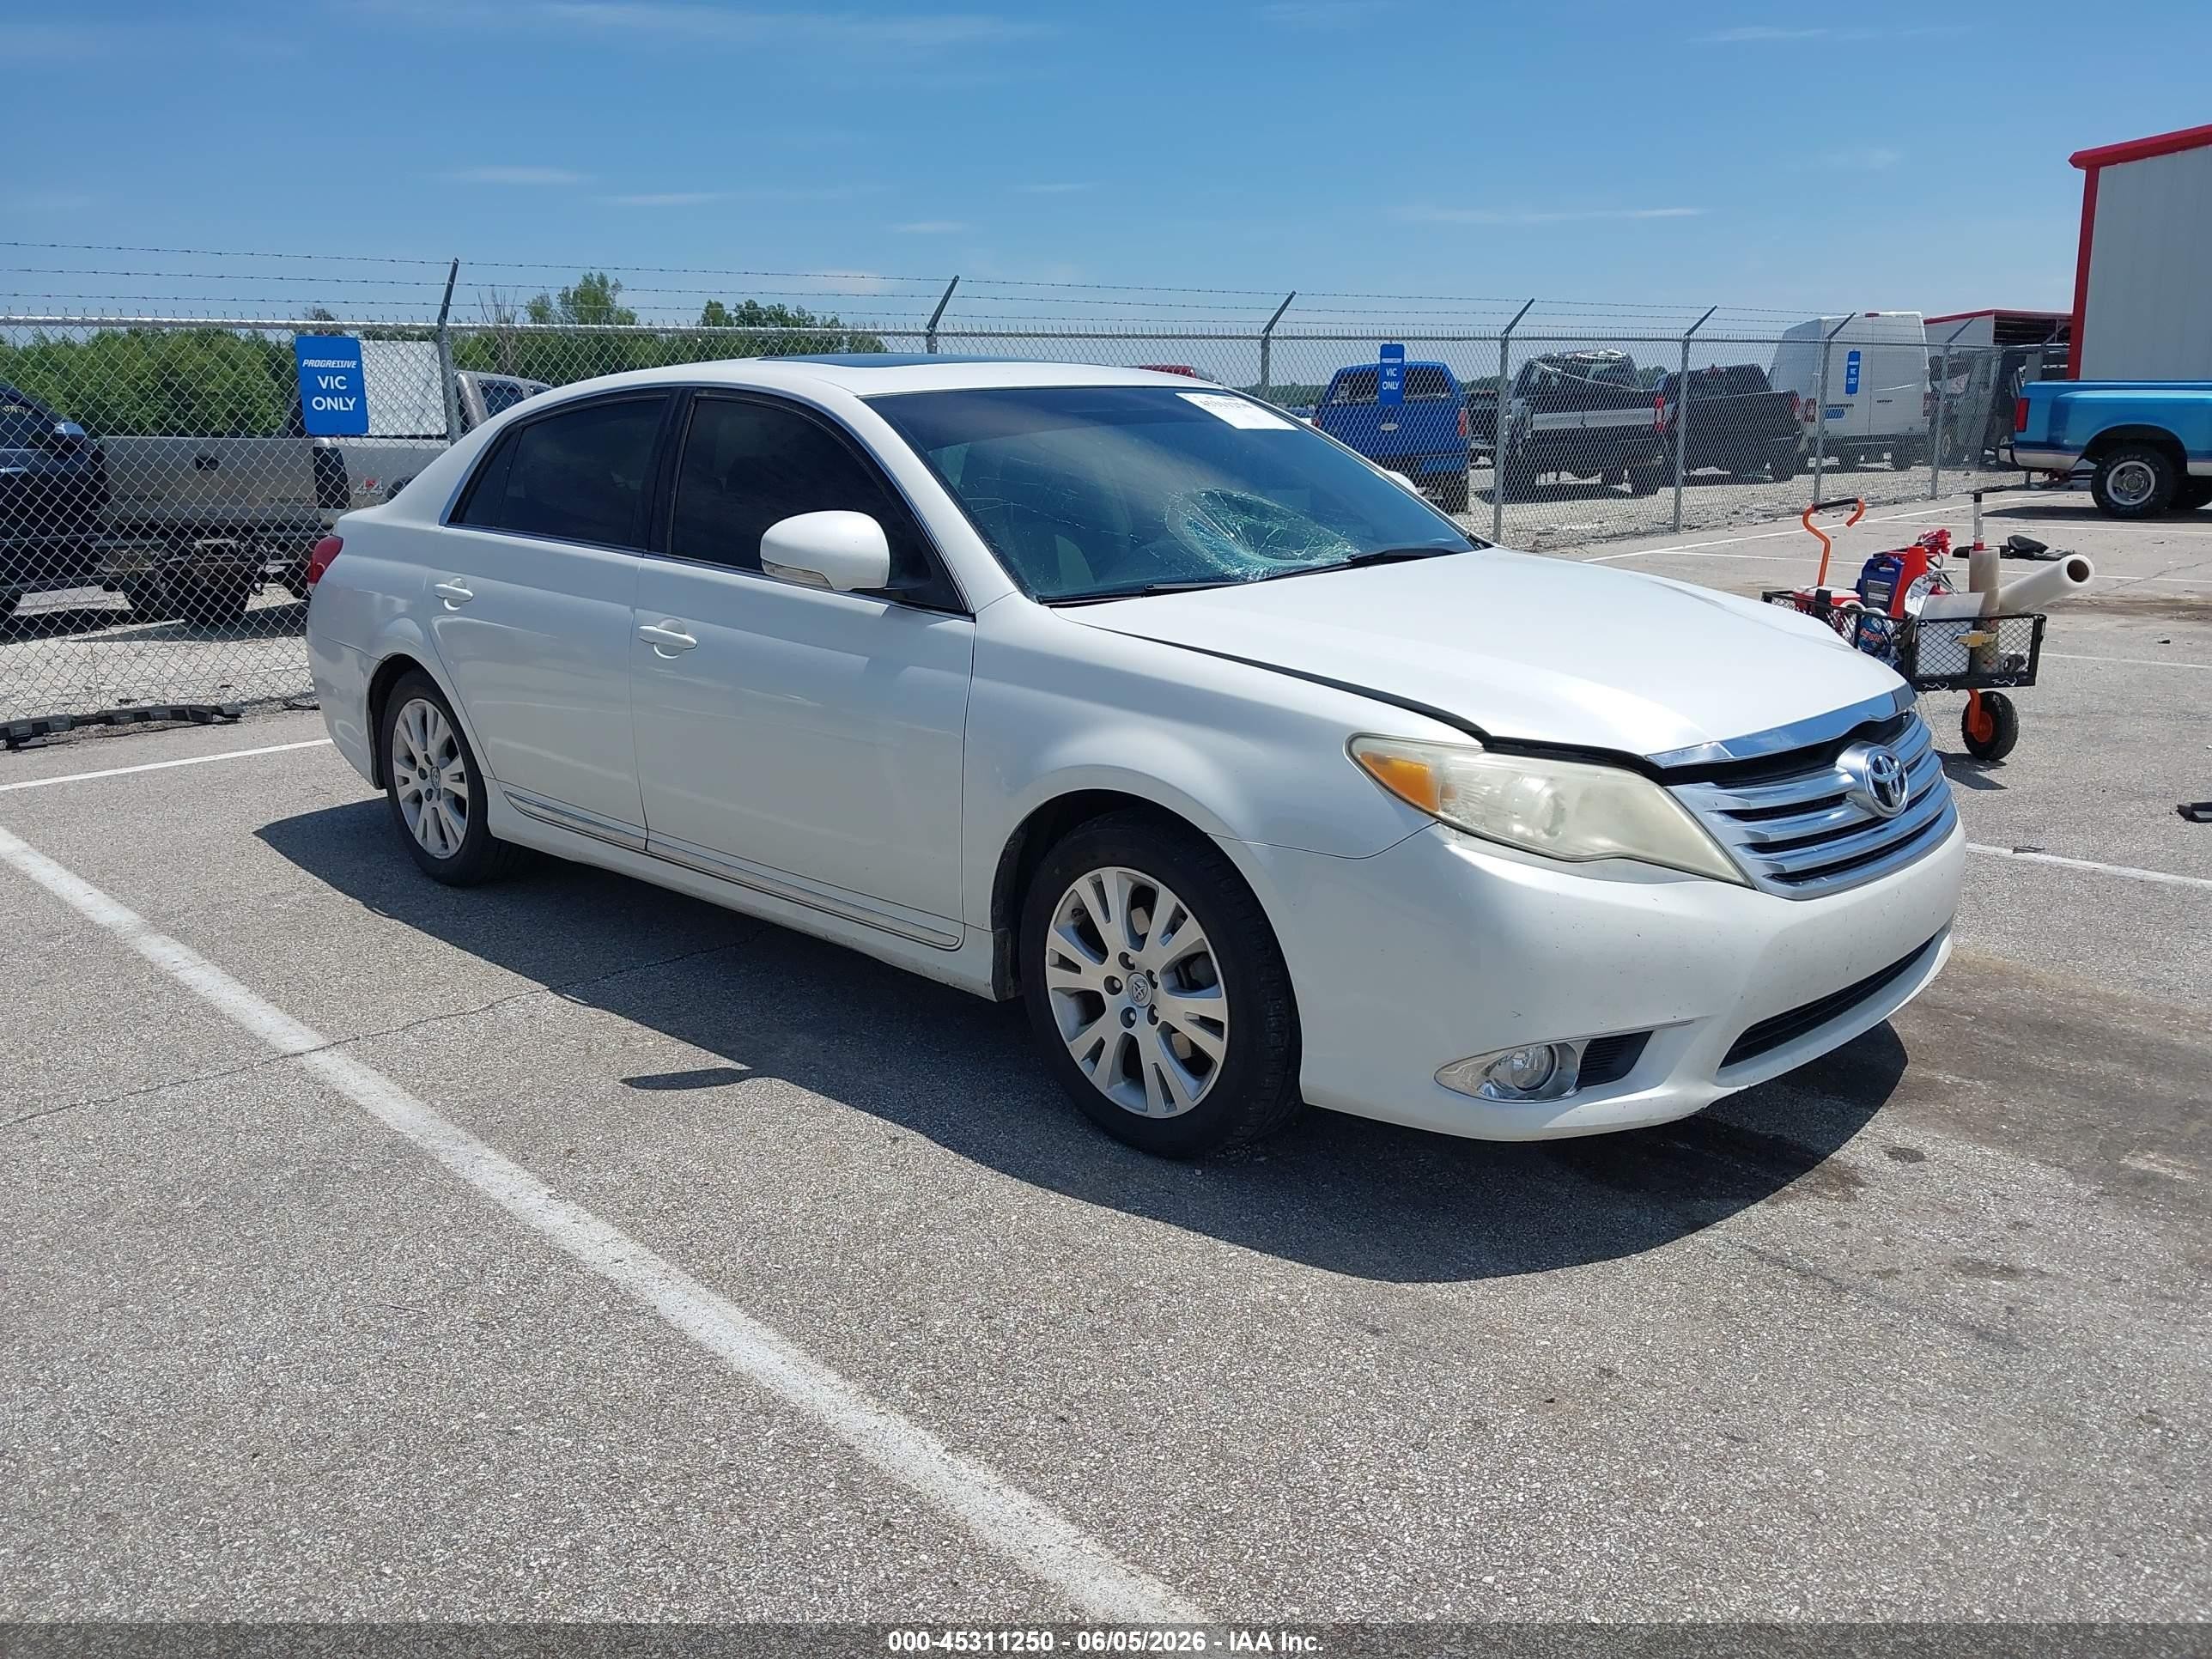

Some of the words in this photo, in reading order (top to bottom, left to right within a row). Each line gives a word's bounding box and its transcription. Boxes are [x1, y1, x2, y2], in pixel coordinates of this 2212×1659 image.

[302, 359, 357, 368] PROGRESSIVE
[318, 376, 347, 390] VIC
[1382, 381, 1400, 390] ONLY
[312, 397, 356, 411] ONLY
